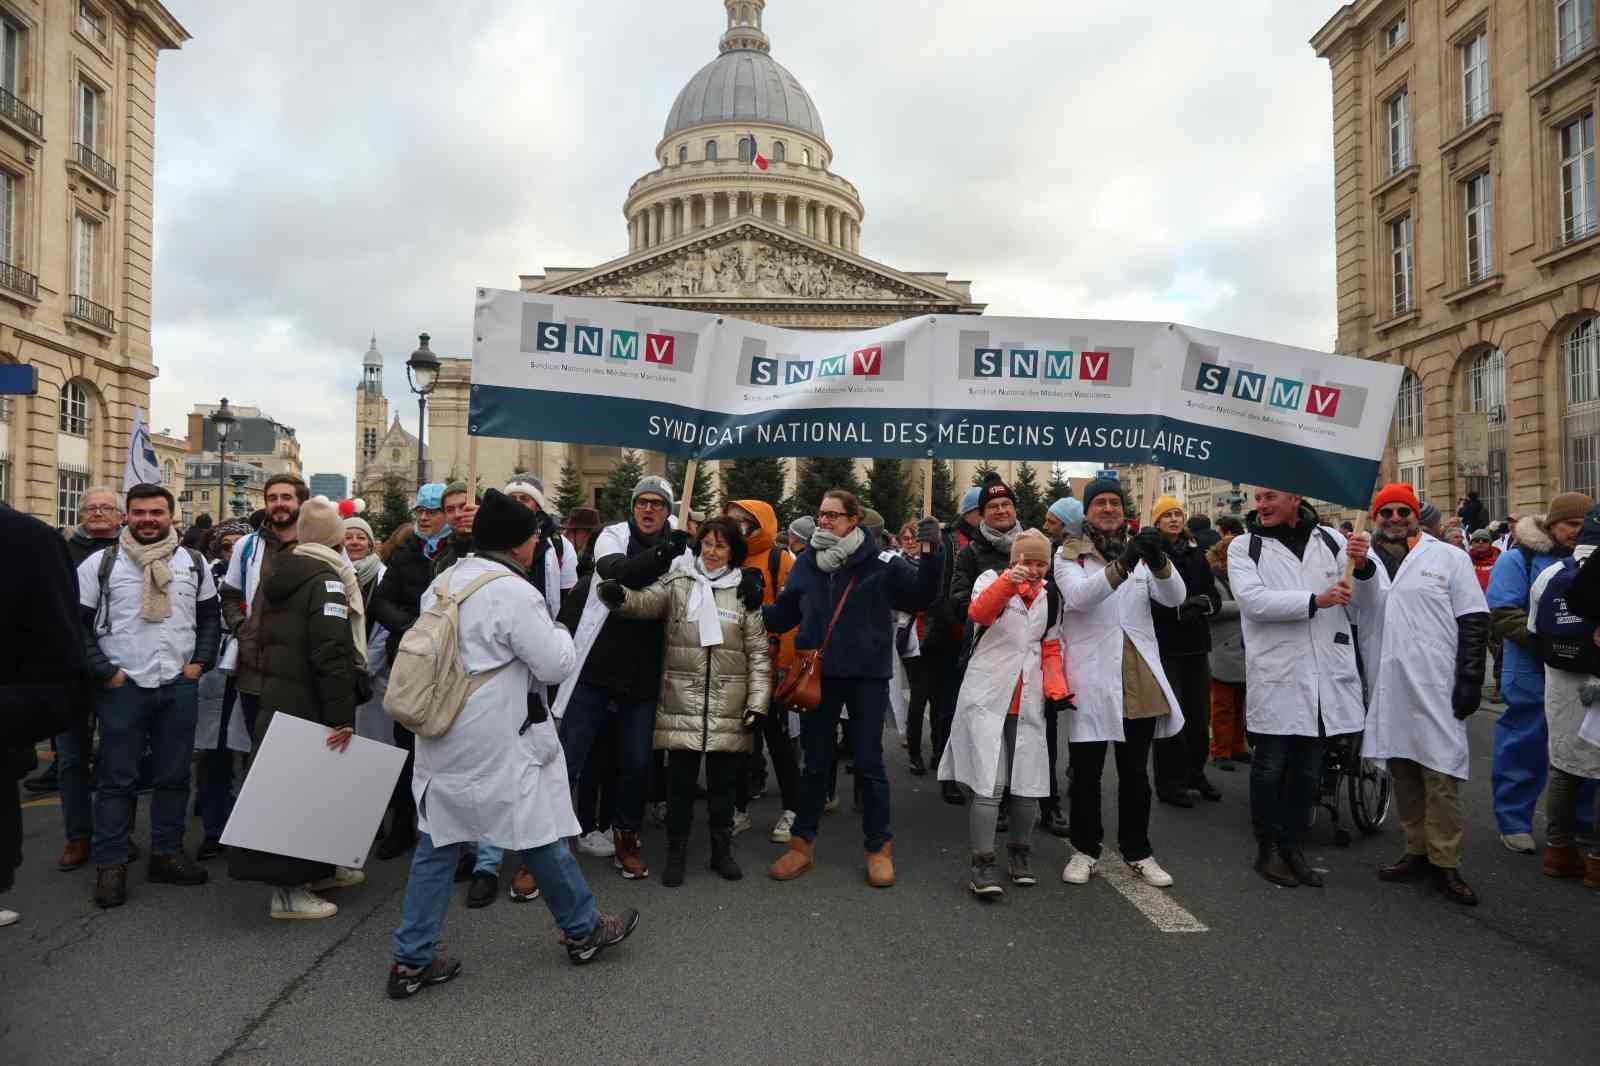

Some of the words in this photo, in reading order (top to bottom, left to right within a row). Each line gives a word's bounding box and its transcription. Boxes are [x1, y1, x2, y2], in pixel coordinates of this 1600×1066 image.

[648, 415, 747, 446] SYNDICAT
[757, 422, 872, 443] NATIONAL
[883, 422, 928, 443] DES
[938, 419, 1055, 446] MÉDECINS
[1064, 426, 1212, 460] VASCULAIRES
